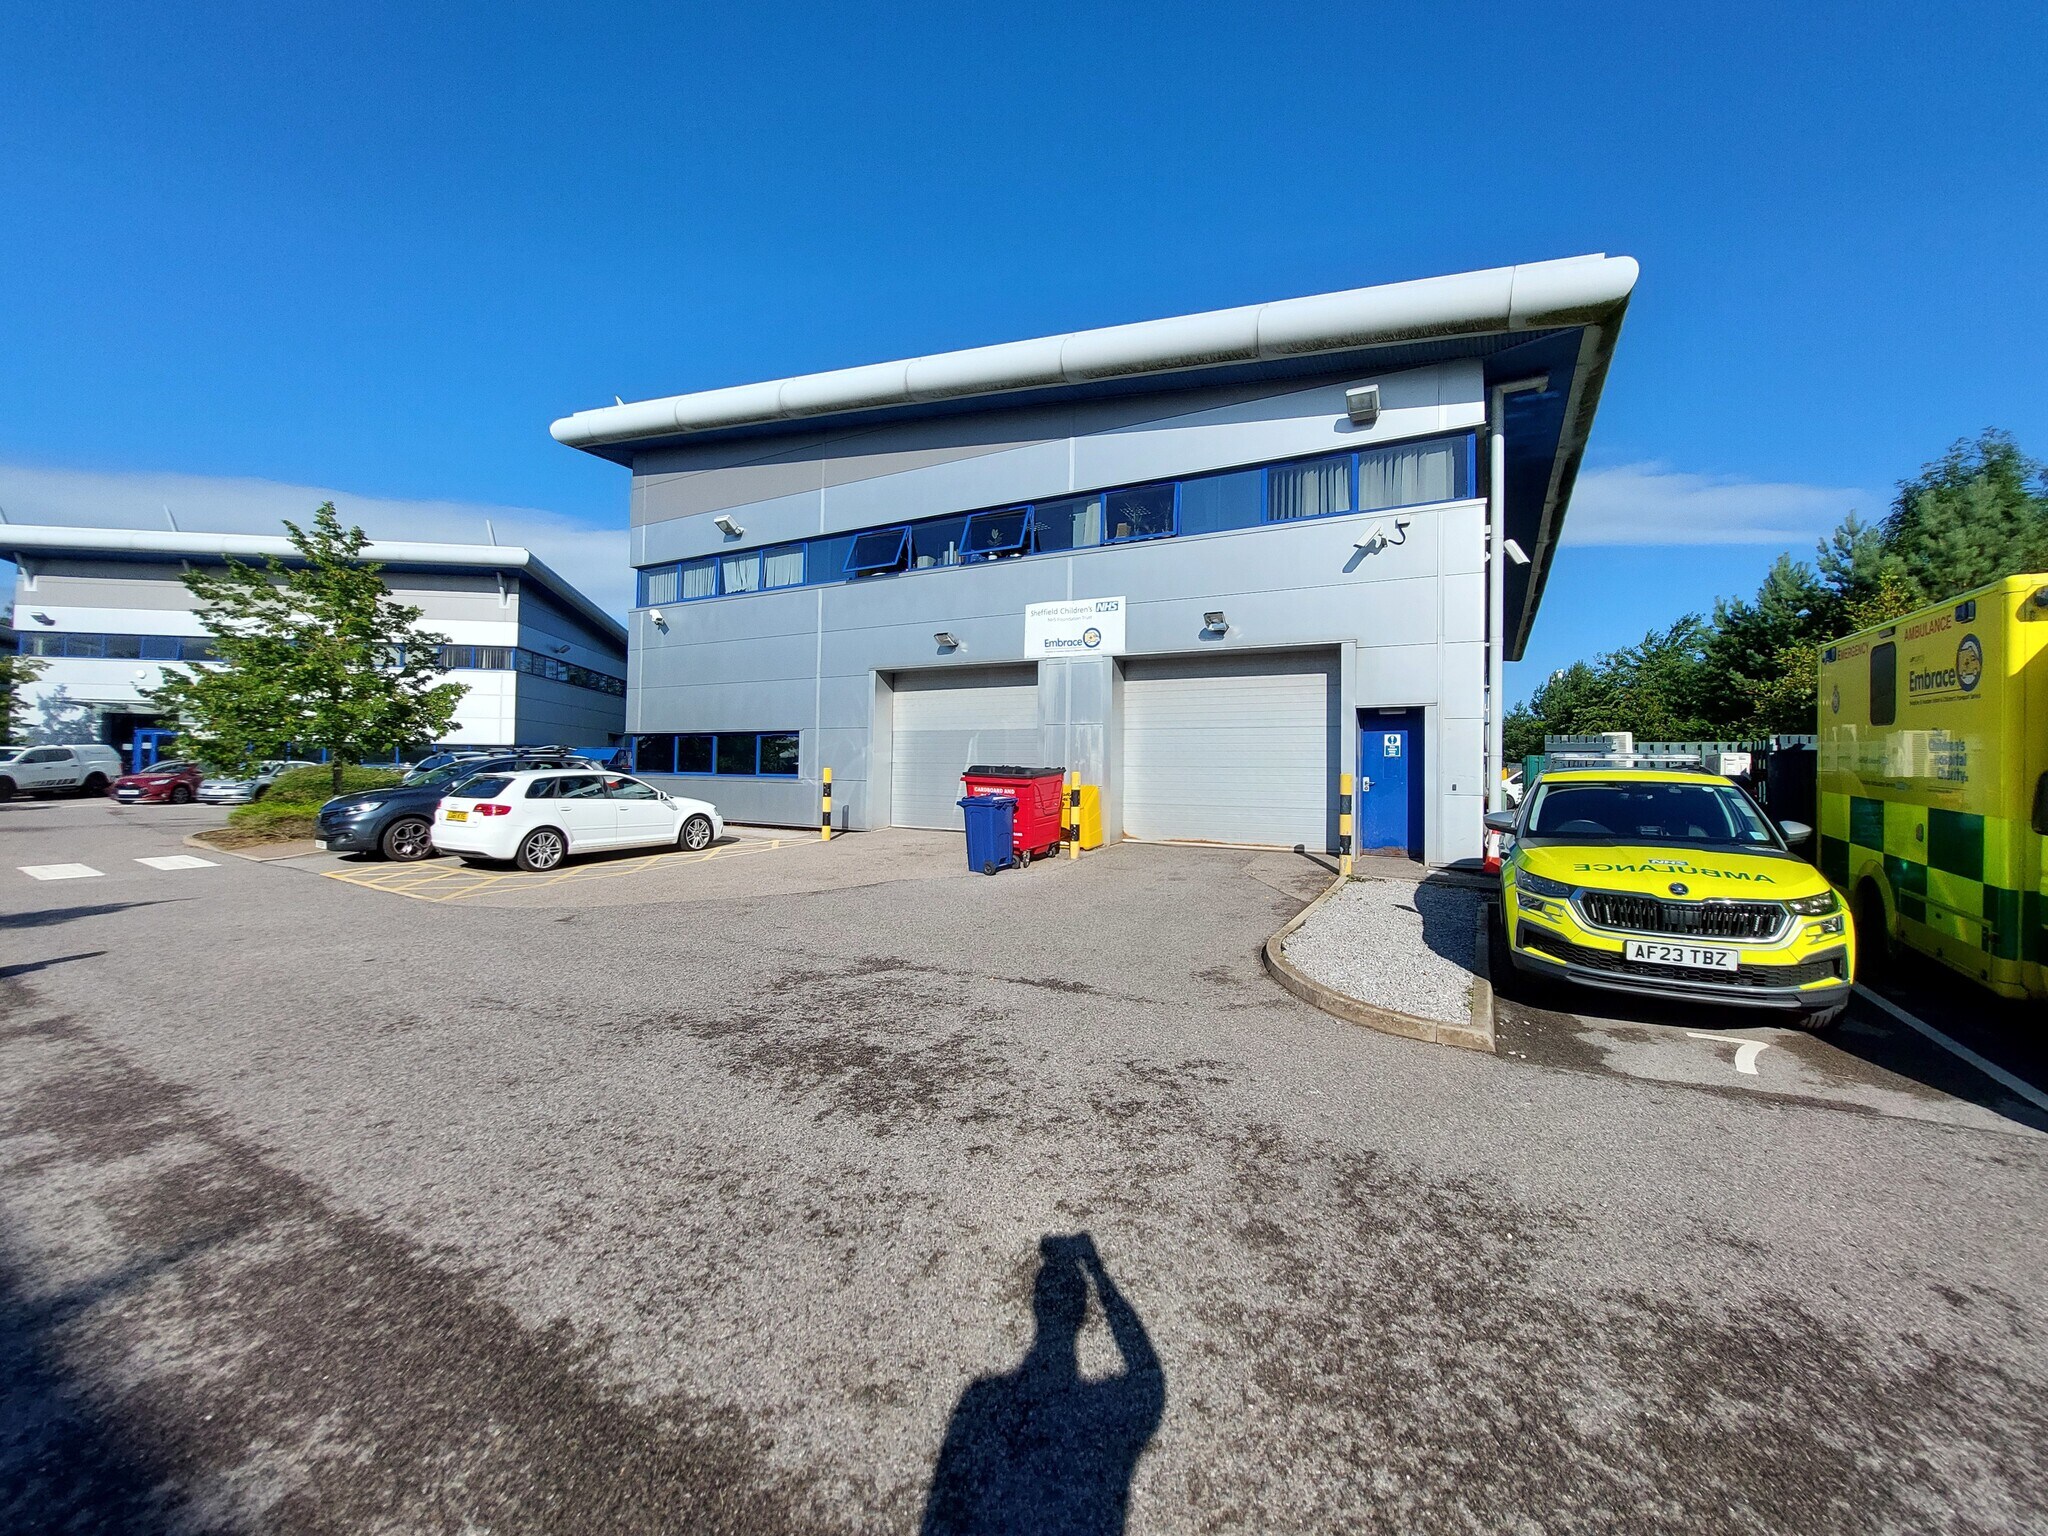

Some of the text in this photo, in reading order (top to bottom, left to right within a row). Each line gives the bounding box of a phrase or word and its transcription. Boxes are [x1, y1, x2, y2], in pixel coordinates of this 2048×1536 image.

[1031, 606, 1092, 617] Sheffield Children's
[1096, 601, 1118, 612] NHS
[1904, 614, 1952, 642] AMBULANCE
[1044, 637, 1083, 648] Embrace
[1838, 643, 1868, 660] EMERGENCY
[1909, 666, 1956, 692] Embrace
[974, 786, 1003, 794] CARDBOARD
[1634, 944, 1728, 967] AF23 TBZ
